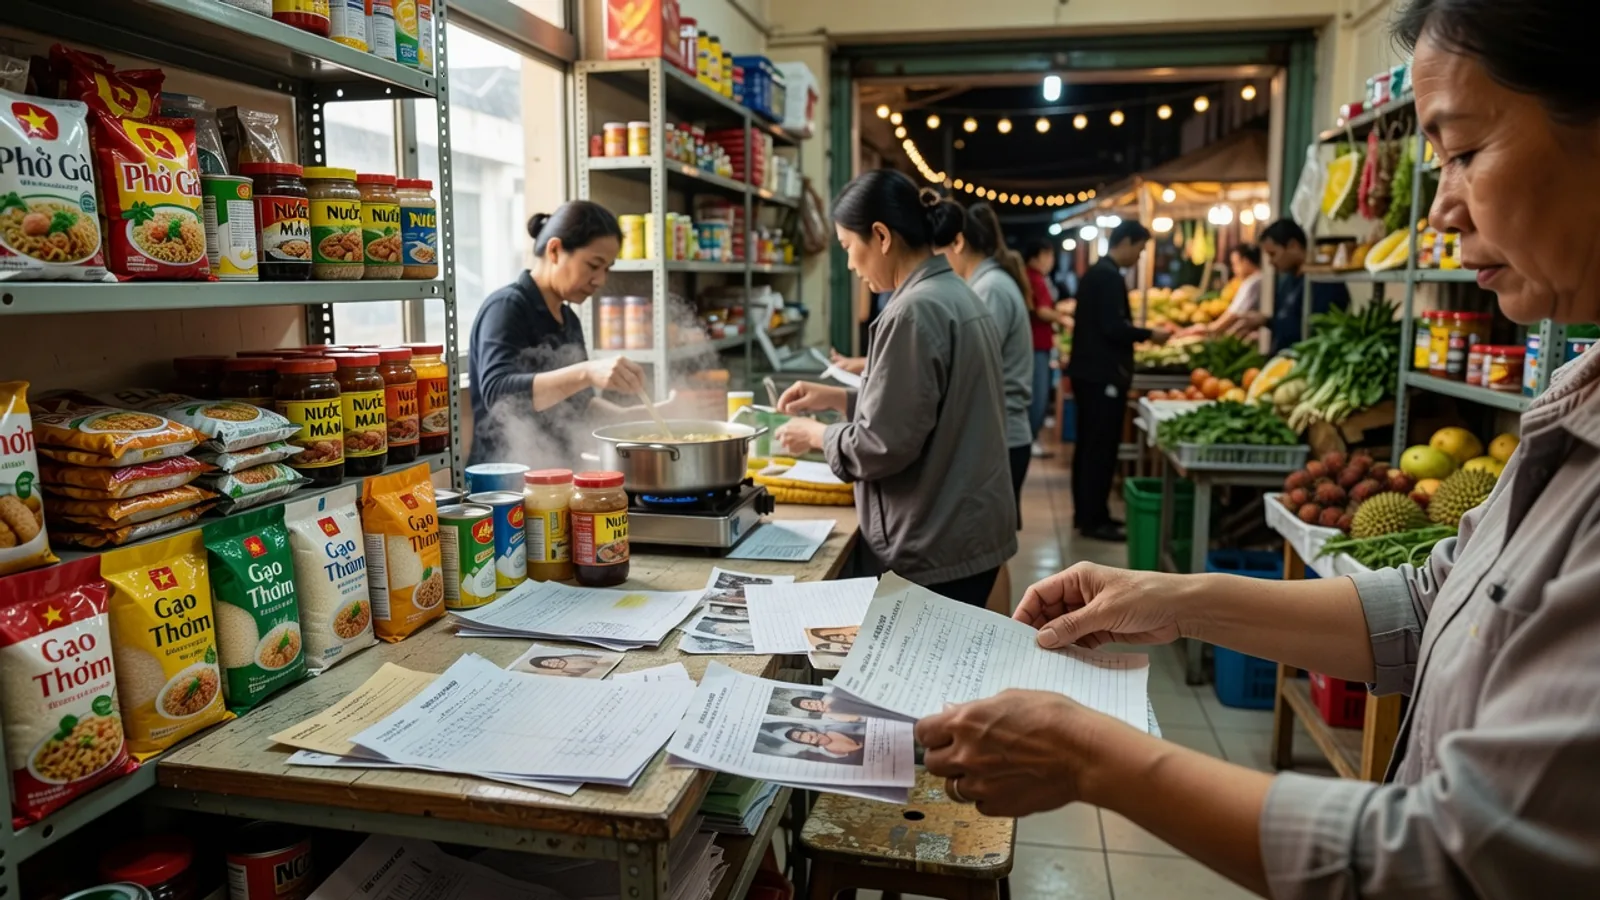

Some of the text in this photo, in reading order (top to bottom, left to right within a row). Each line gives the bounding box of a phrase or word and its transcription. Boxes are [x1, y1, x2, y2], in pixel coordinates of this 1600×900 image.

[59, 153, 93, 184] Gà
[325, 539, 356, 560] Gạo
[248, 561, 282, 583] Gạo
[154, 594, 197, 618] Gạo
[41, 633, 96, 663] Gạo
[32, 656, 111, 698] Thơm
